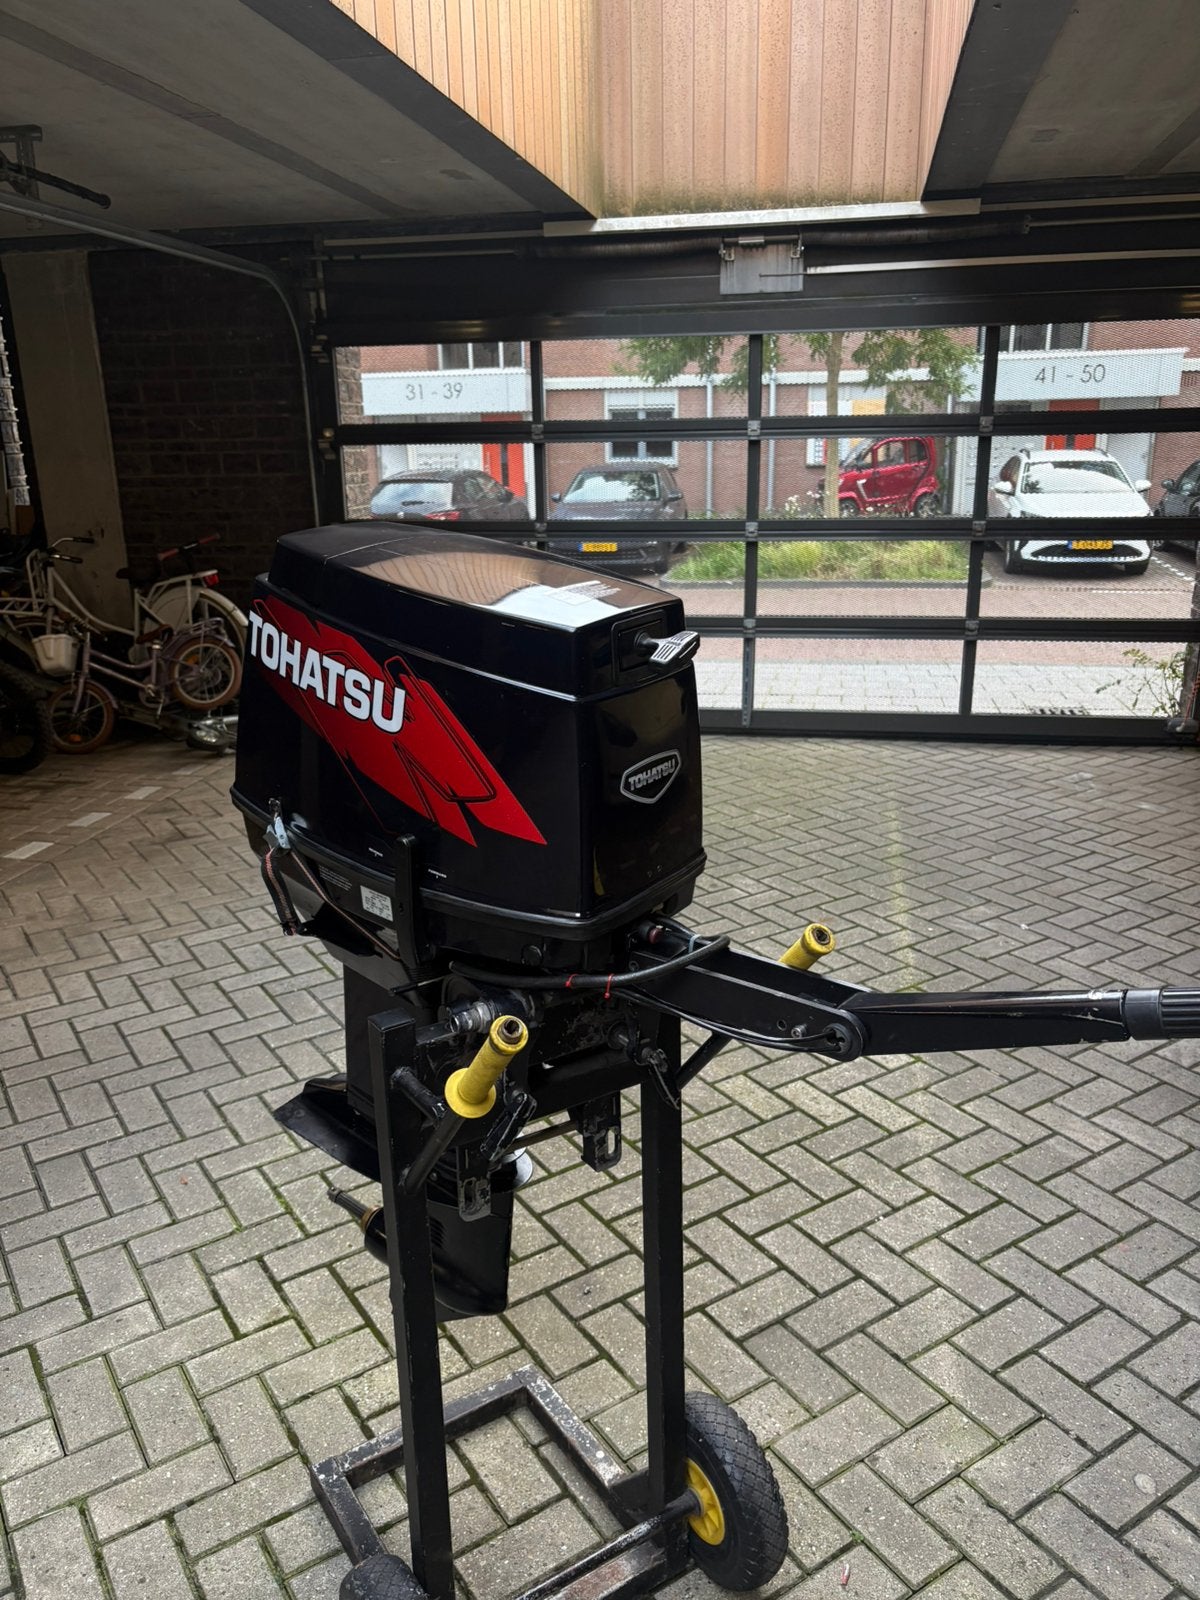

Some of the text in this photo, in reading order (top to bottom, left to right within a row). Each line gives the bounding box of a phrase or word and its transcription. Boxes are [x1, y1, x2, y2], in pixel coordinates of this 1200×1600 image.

[1034, 366, 1056, 383] 41
[1080, 363, 1106, 383] 50
[405, 384, 424, 400] 31
[443, 382, 463, 399] 39
[249, 610, 406, 733] TOHATSU
[628, 758, 676, 791] TOHATSU
